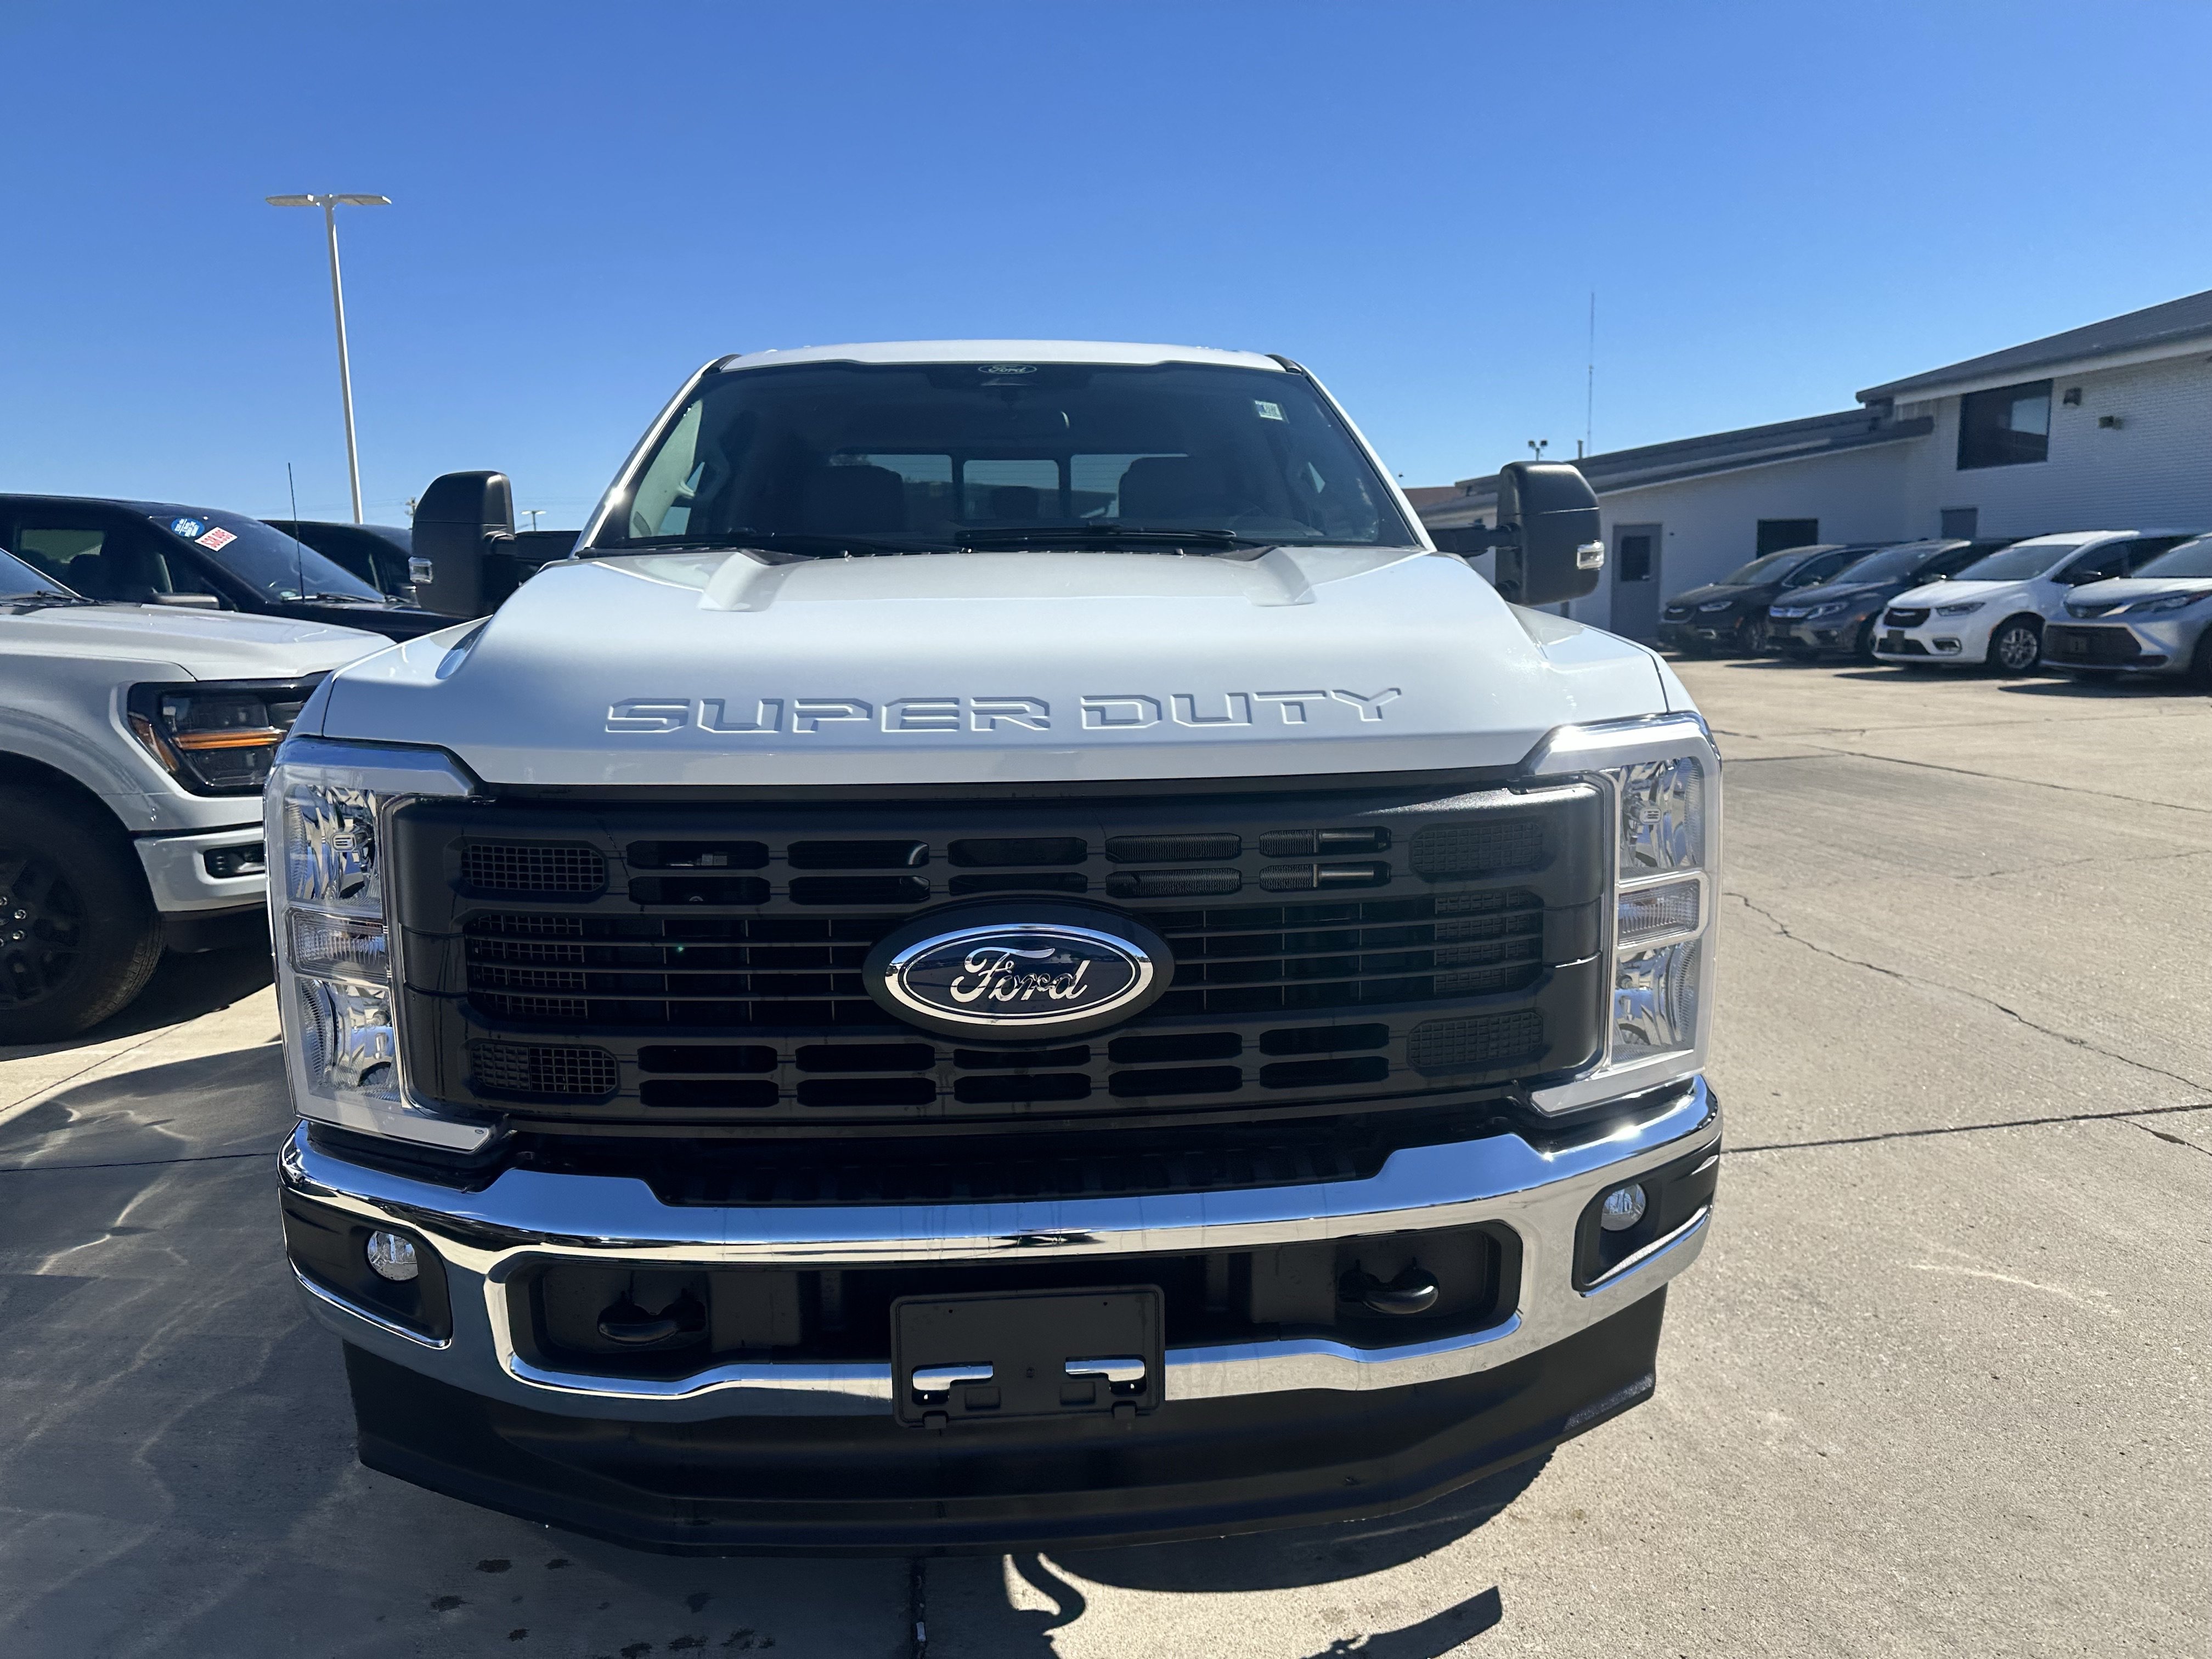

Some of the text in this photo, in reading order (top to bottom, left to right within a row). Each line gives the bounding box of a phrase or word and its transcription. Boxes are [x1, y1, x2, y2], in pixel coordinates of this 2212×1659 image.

[605, 687, 1401, 733] SUPER DUTY
[950, 946, 1091, 1002] Ford
